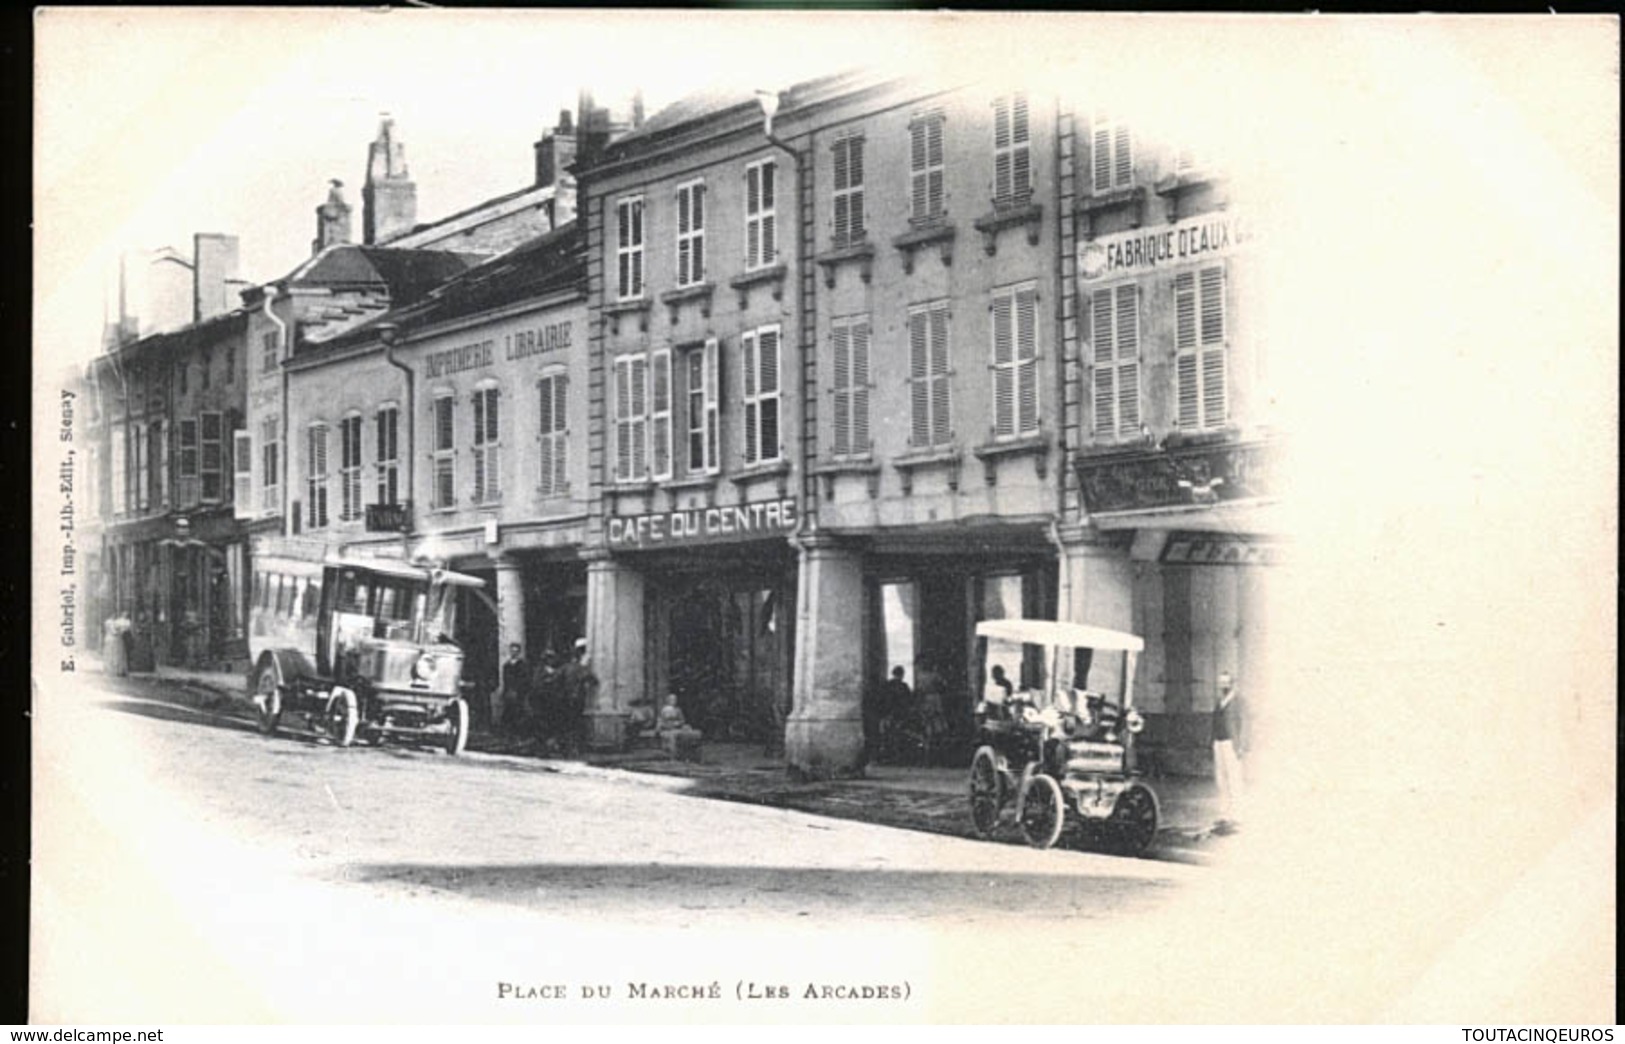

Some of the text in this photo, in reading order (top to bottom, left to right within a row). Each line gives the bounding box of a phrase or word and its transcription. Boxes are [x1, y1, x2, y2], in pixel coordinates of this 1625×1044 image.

[1107, 229, 1174, 272] FABRIQUE
[426, 320, 572, 379] IMPRIMERIE LIBRAIRIE
[60, 389, 76, 442] Stenay
[609, 500, 796, 546] CAFE DU CENTRE
[61, 583, 76, 647] Gabriel,
[61, 653, 75, 672] E.
